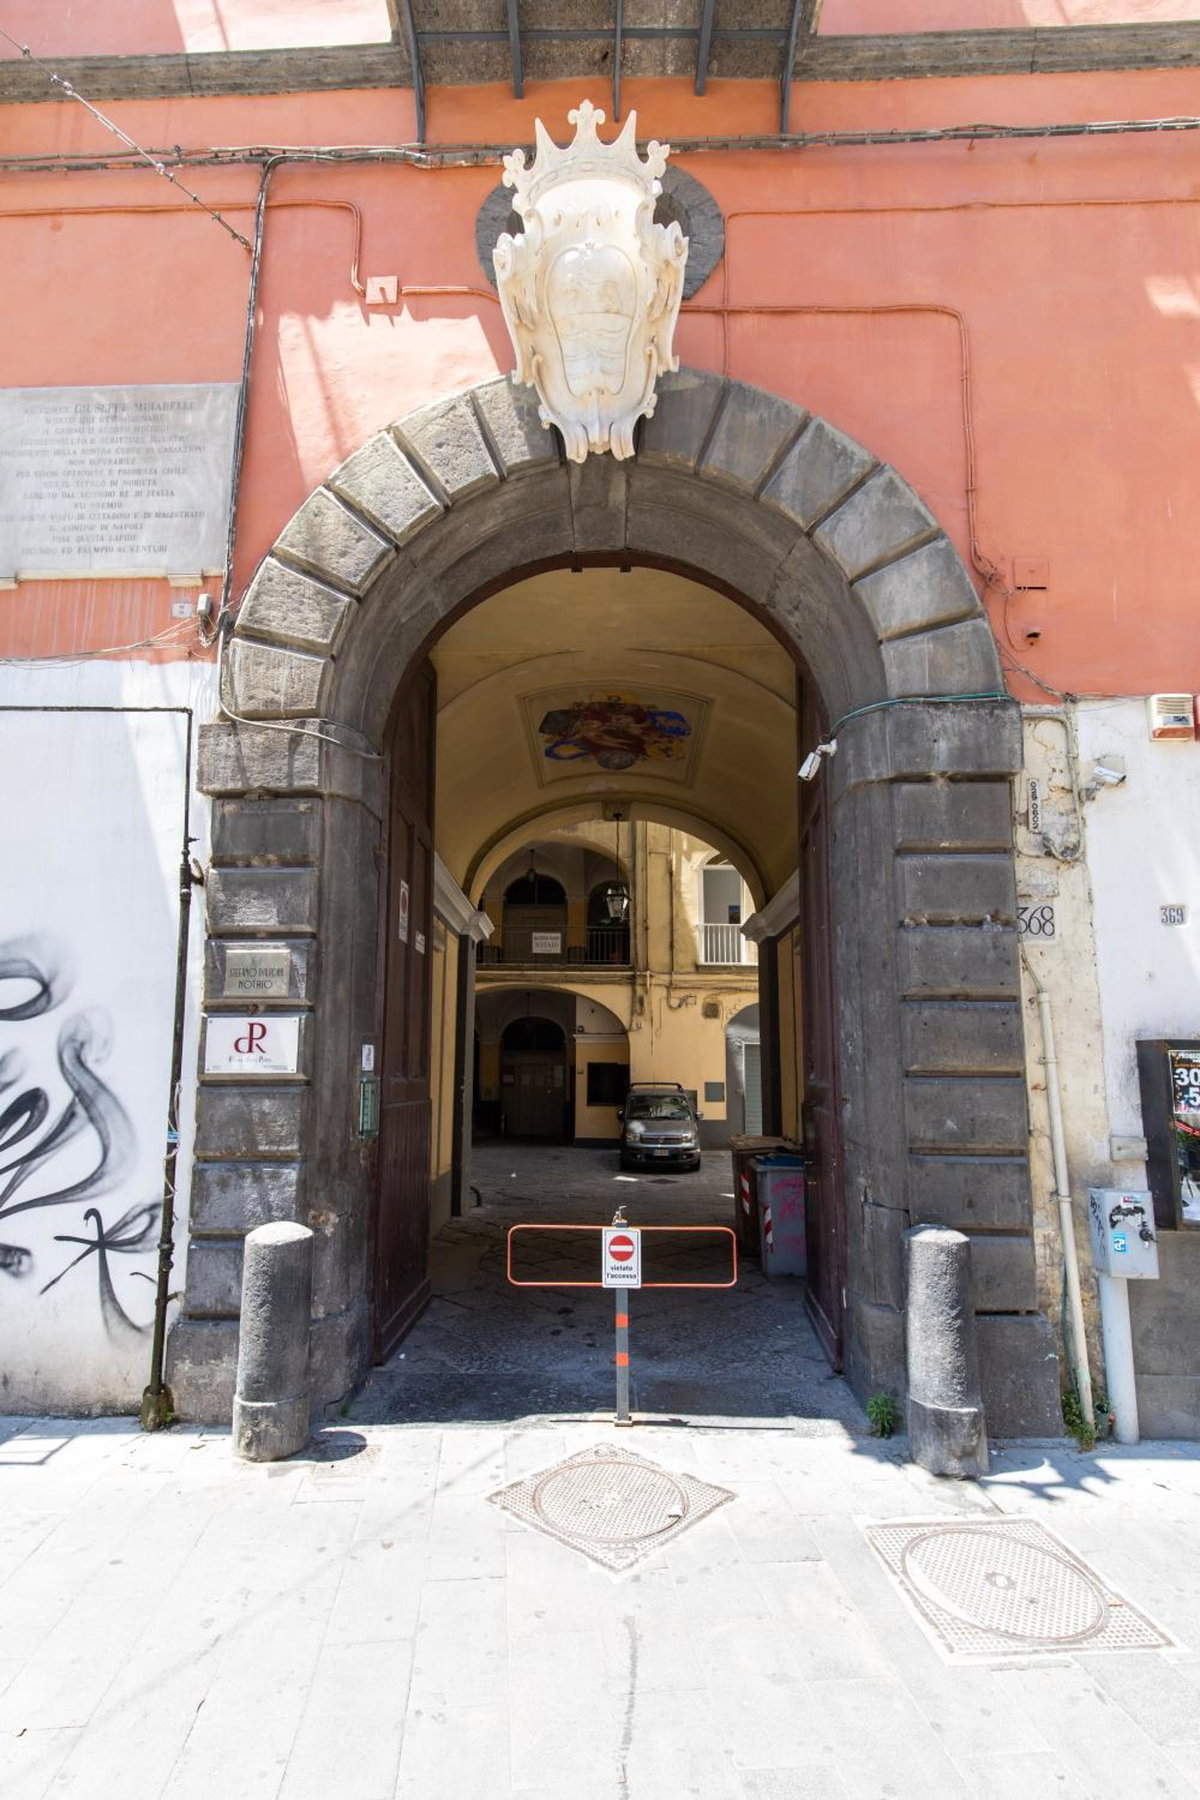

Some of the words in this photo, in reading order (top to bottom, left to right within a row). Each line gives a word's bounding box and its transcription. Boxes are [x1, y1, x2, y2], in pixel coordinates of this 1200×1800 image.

[1017, 906, 1055, 936] 368
[1161, 907, 1184, 925] 369
[238, 979, 273, 990] NOTAIO
[610, 1264, 633, 1272] vietato
